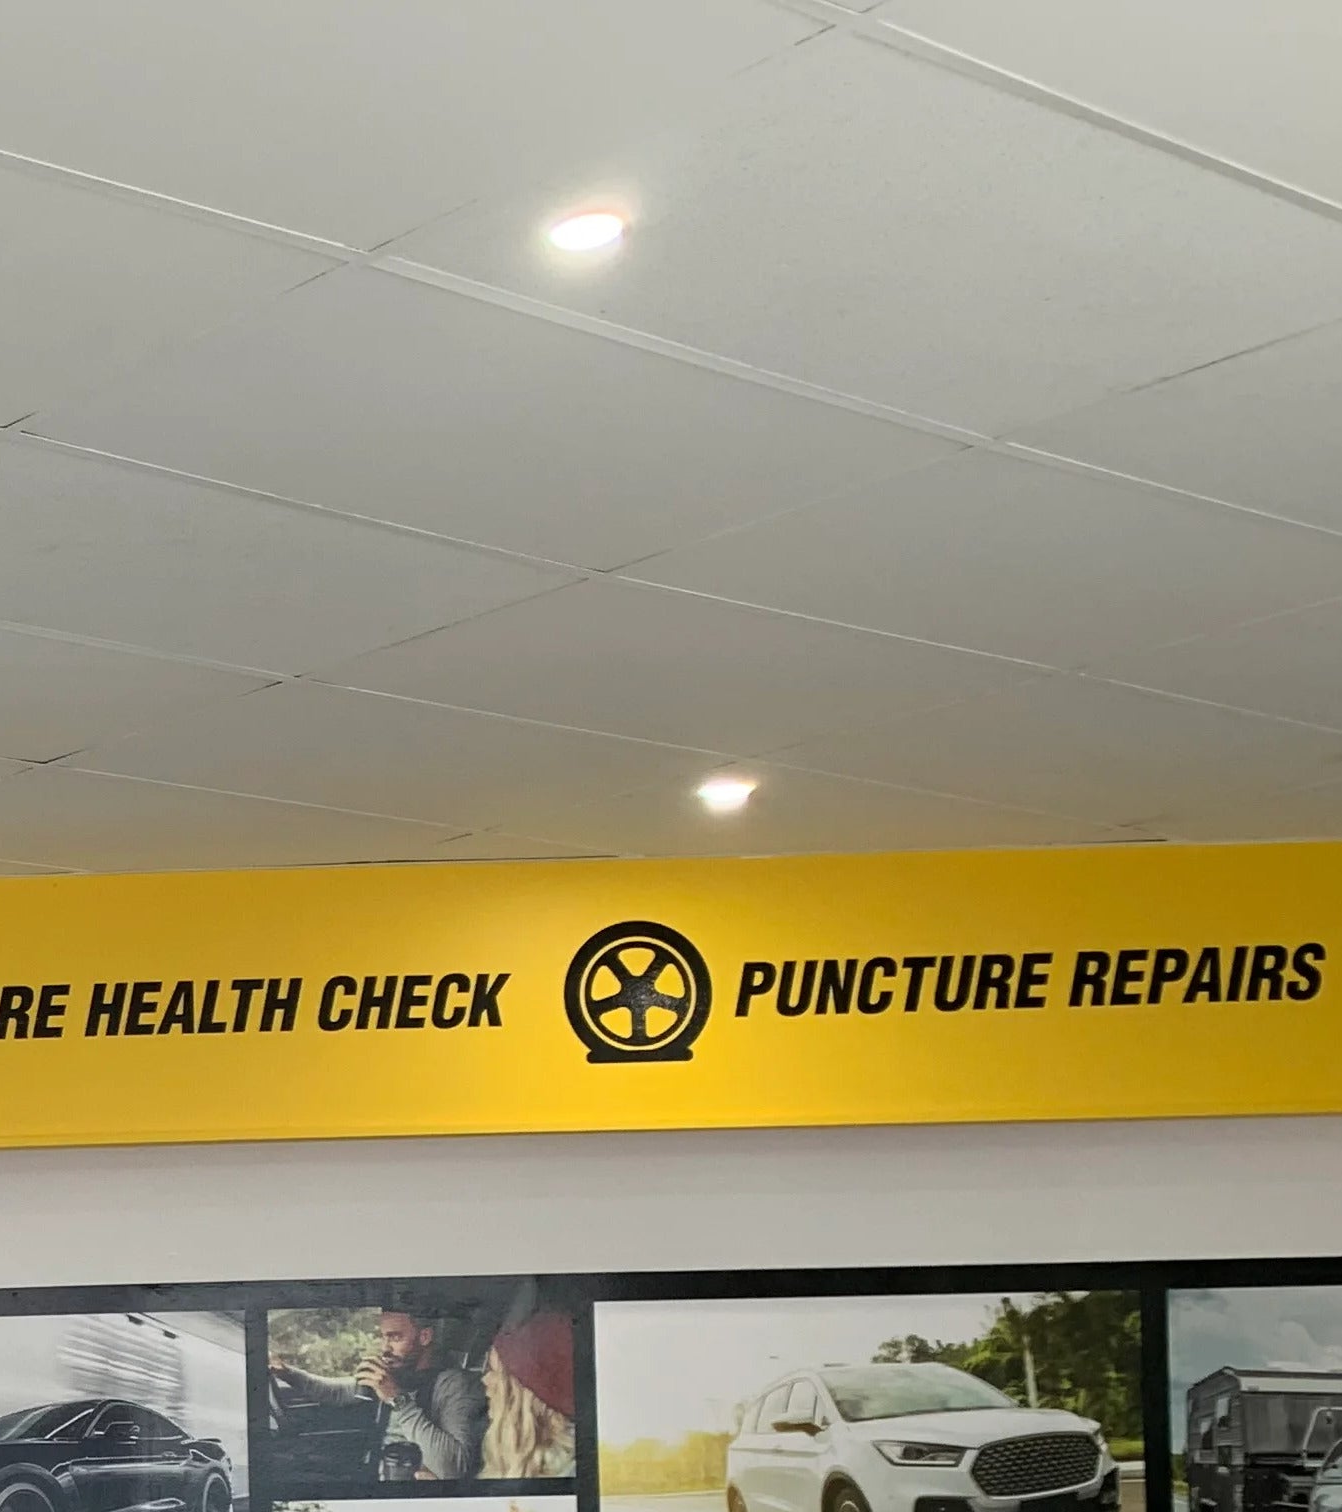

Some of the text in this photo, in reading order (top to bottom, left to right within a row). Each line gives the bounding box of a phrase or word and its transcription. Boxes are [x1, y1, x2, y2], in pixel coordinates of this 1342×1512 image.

[84, 977, 303, 1037] HEALTH
[317, 972, 512, 1032] CHECK
[735, 942, 1326, 1018] PUNCTURE REPAIRS
